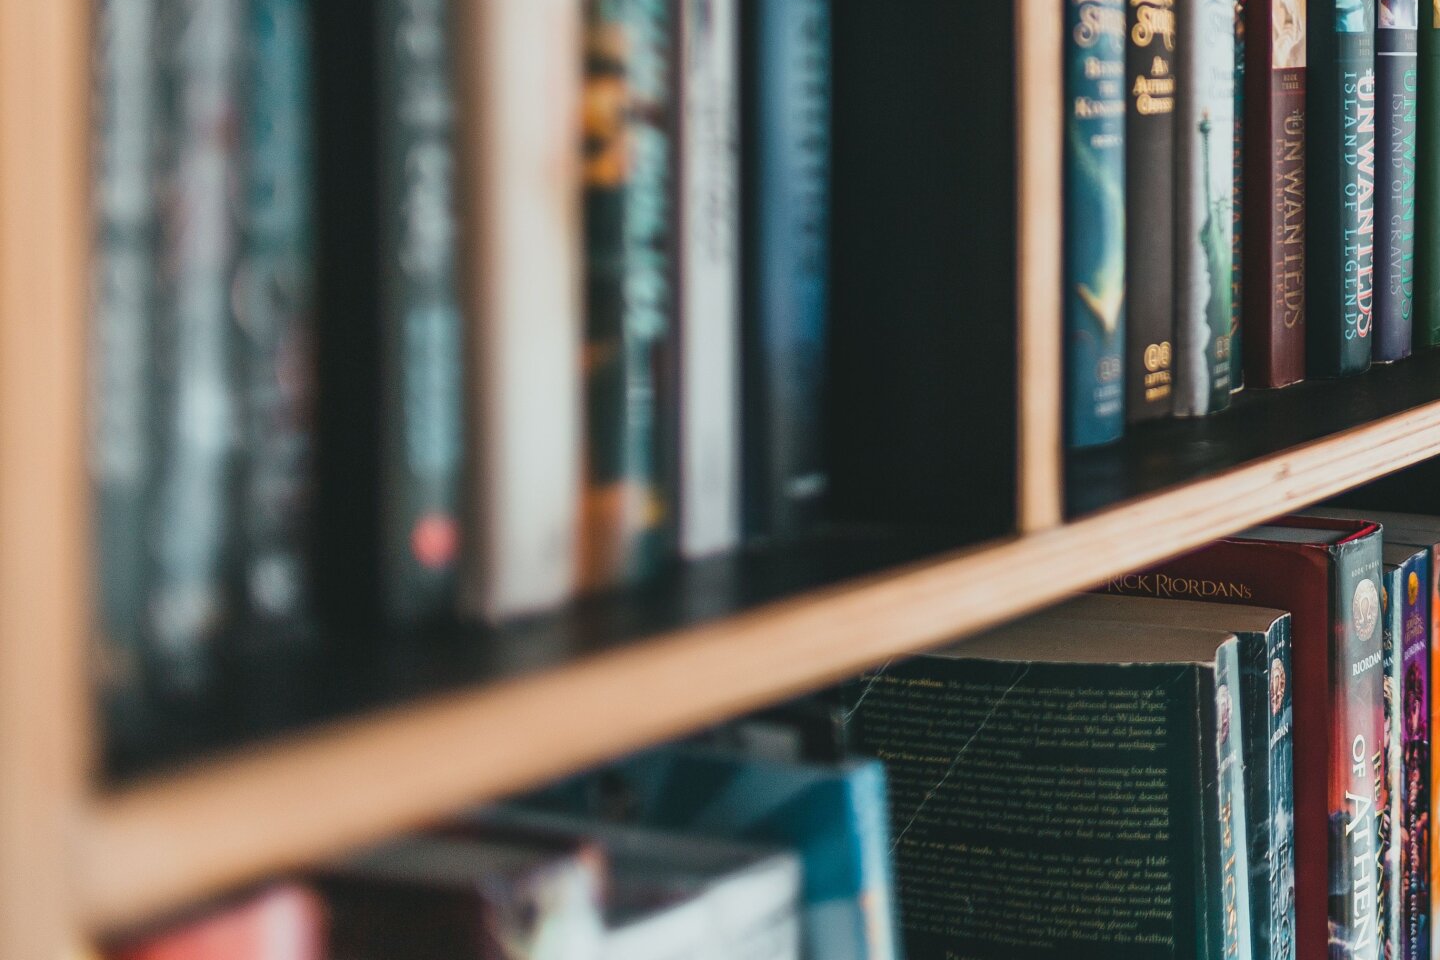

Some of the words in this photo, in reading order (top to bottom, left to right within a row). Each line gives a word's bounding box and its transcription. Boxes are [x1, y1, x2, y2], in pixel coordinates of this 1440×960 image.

[1345, 72, 1357, 166] ISLAND
[1392, 93, 1402, 168] ISLAND
[1275, 139, 1284, 212] ISLAND
[1345, 182, 1357, 212] OF
[1356, 74, 1375, 338] UNWANTEDS
[1402, 70, 1417, 320] UNWANTEDS
[1284, 113, 1304, 329] UNWANTEDS
[1390, 215, 1401, 295] GRAVES
[1345, 228, 1357, 340] LEGENDS
[1156, 573, 1252, 599] RIORDAN'S
[1351, 566, 1364, 578] BOOK
[1364, 560, 1381, 573] THREE
[1352, 650, 1382, 676] RIORDAN
[1353, 734, 1366, 778] OF
[1345, 790, 1373, 960] ATHEN
